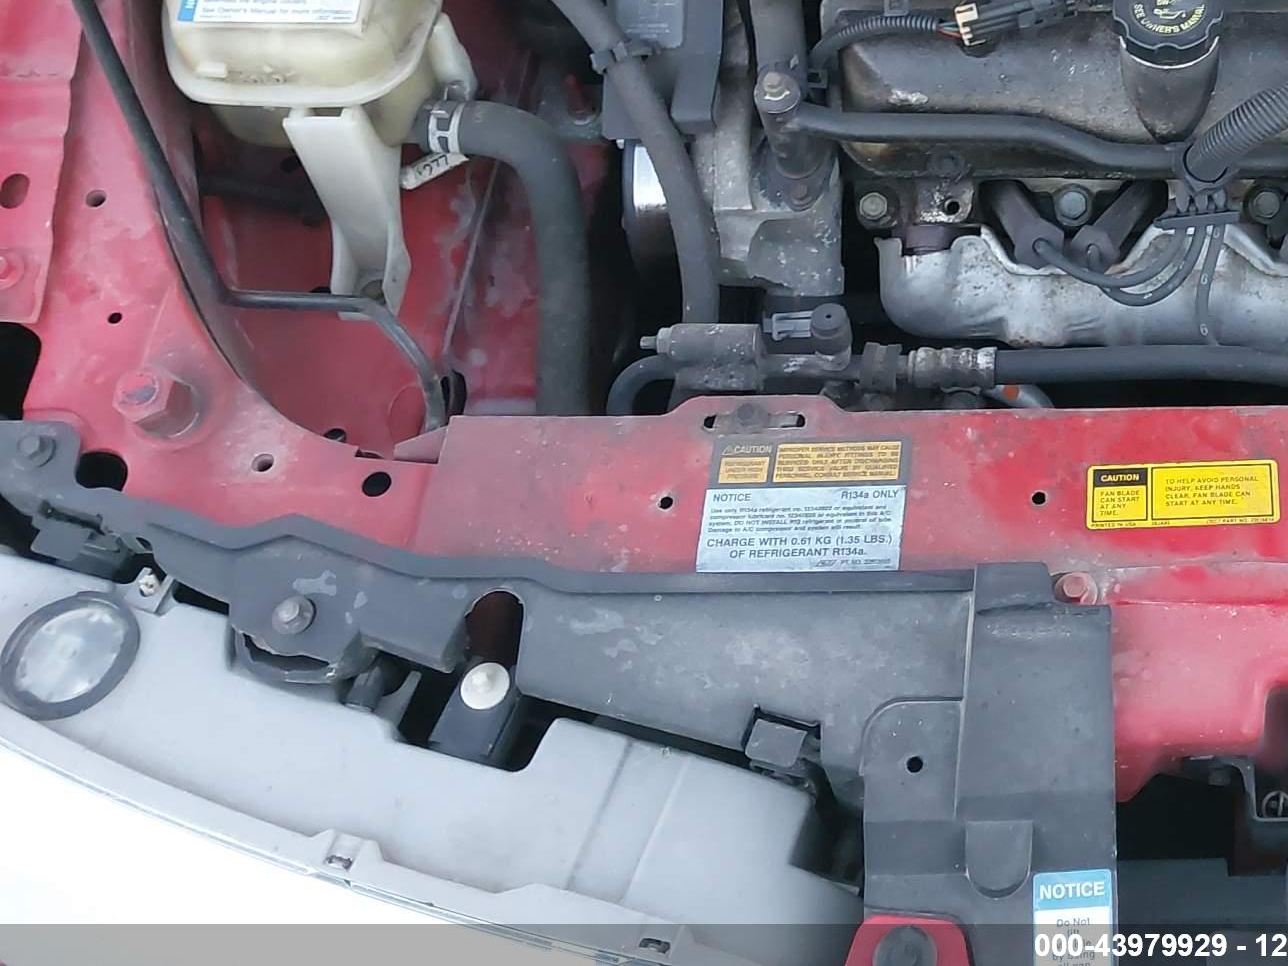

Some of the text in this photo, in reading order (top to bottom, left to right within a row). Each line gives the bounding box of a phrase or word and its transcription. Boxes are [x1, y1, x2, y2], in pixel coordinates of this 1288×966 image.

[1134, 4, 1205, 33] SEE OWNER'S MANUAL
[1200, 324, 1208, 336] 6
[734, 446, 772, 454] CAUTION
[1101, 474, 1139, 482] CAUTION
[713, 490, 899, 502] NOTICE R134a ONLY
[707, 534, 892, 547] CHARGE WITH 0.61 KG (1.35 LBS.)
[729, 548, 867, 559] OF REFRIGERANT R134a.
[1040, 882, 1104, 899] NOTICE
[1057, 918, 1090, 927] Do Not
